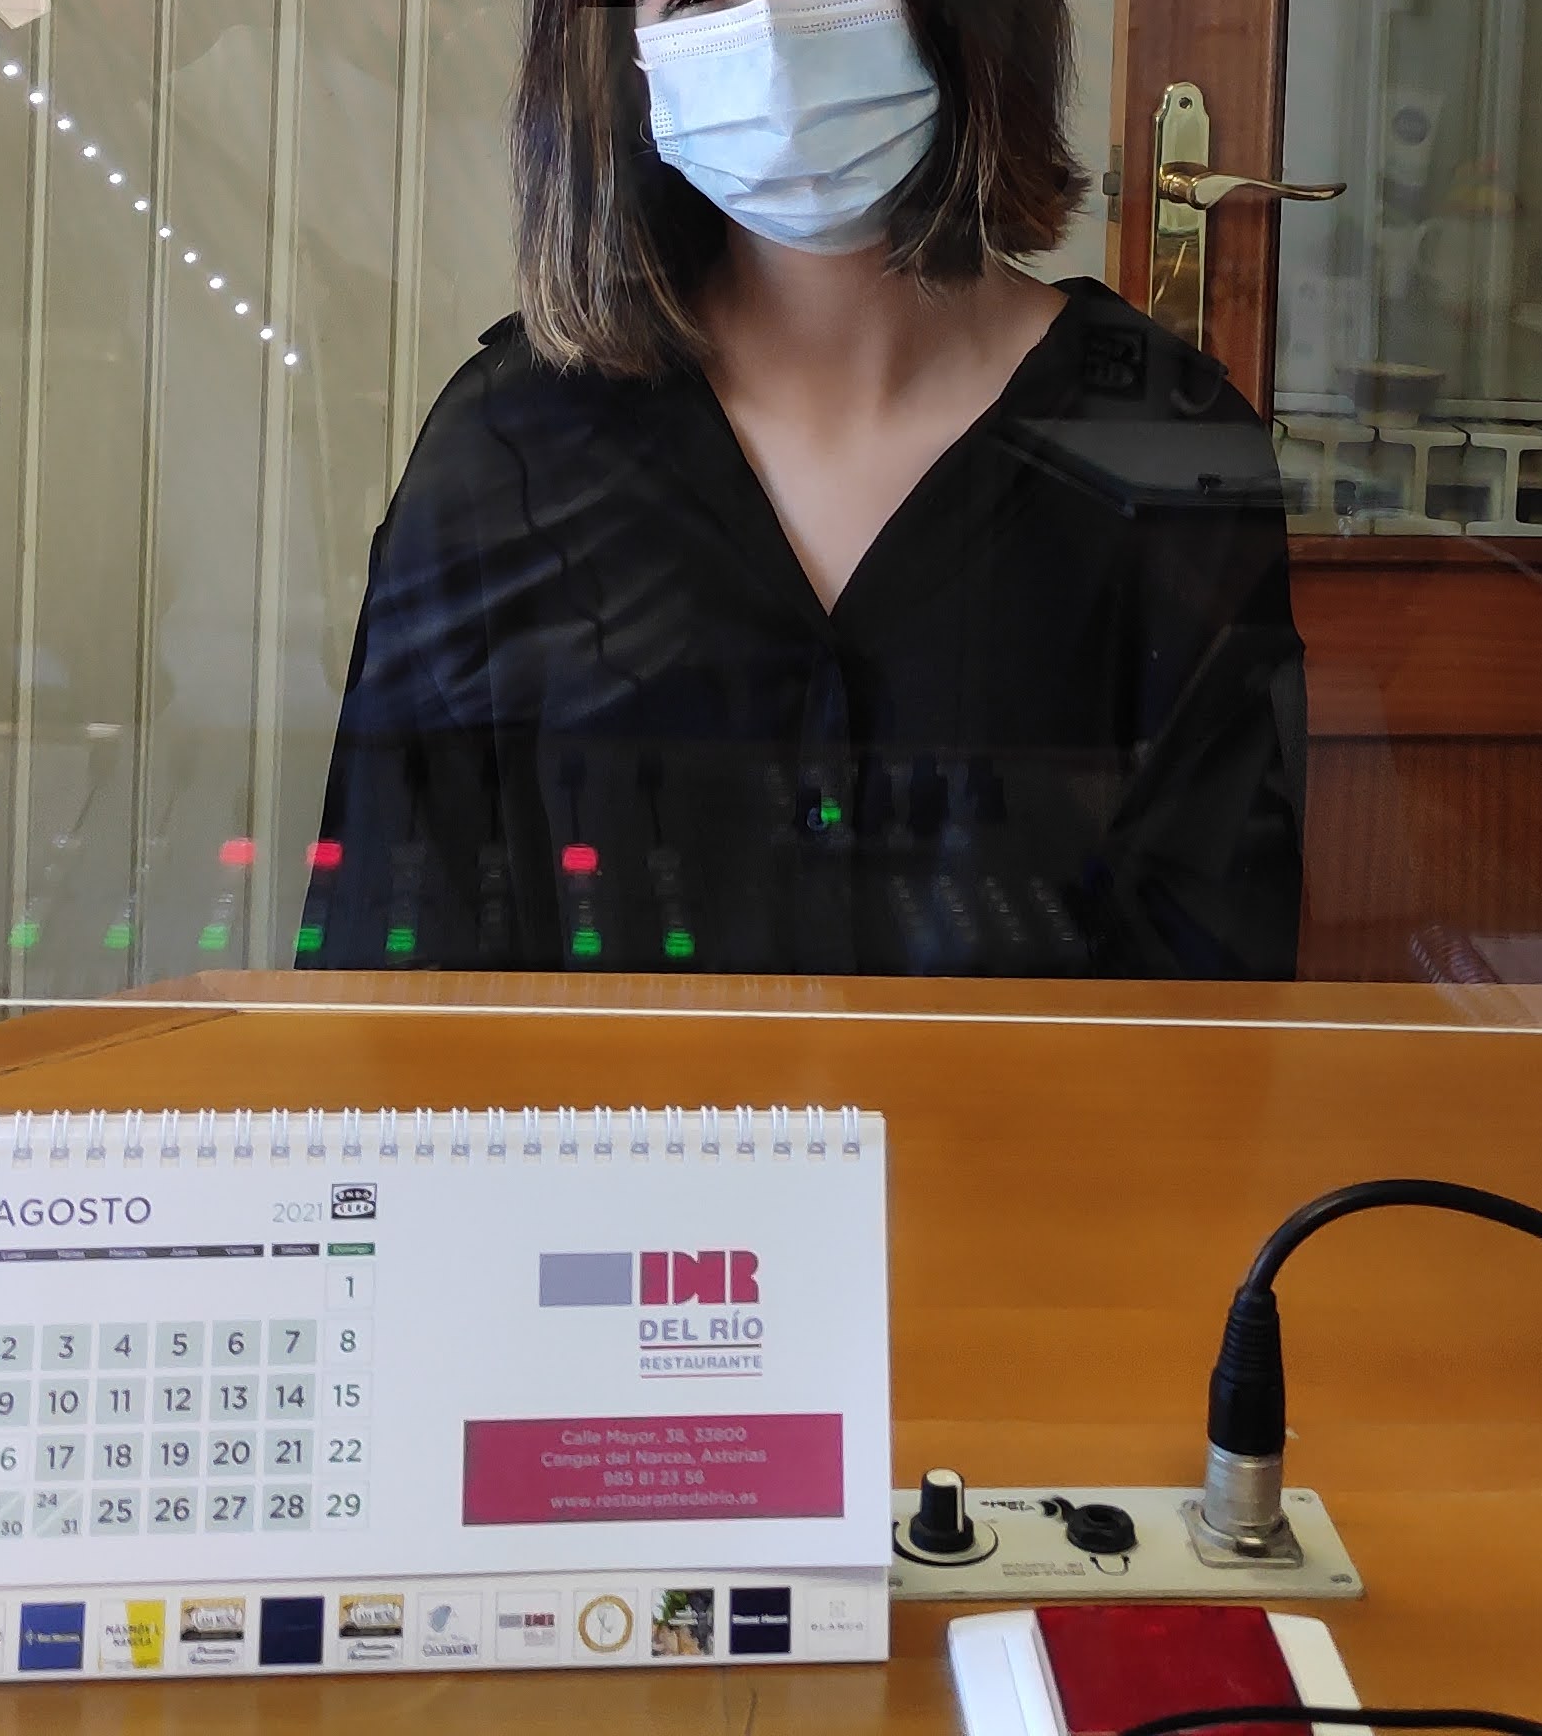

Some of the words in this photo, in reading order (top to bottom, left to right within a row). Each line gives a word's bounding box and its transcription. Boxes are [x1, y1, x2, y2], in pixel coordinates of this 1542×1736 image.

[272, 1202, 324, 1223] 2021
[345, 1276, 354, 1298] 1
[639, 1318, 698, 1341] DEL
[710, 1310, 764, 1340] RÍO
[1, 1336, 18, 1360] 2
[59, 1335, 74, 1359] 3
[114, 1334, 132, 1357] 4
[171, 1333, 188, 1357] 5
[228, 1332, 245, 1355] 6
[285, 1330, 301, 1354] 7
[339, 1329, 356, 1353] 8
[640, 1354, 763, 1370] RESTAURANTE
[48, 1390, 79, 1414] 10
[110, 1389, 131, 1413] 11
[164, 1388, 191, 1411] 12
[220, 1386, 248, 1410] 13
[275, 1385, 305, 1408] 14
[333, 1384, 360, 1407] 15
[562, 1429, 601, 1446] Calle
[47, 1445, 74, 1470] 17
[104, 1444, 132, 1467] 18
[160, 1442, 189, 1466] 19
[213, 1441, 250, 1464] 20
[275, 1440, 302, 1463] 21
[328, 1439, 362, 1462] 22
[541, 1451, 600, 1469] Cangas
[606, 1450, 630, 1466] del
[702, 1447, 767, 1464] Asturias
[98, 1498, 132, 1523] 25
[155, 1498, 189, 1522] 26
[213, 1495, 247, 1521] 27
[270, 1494, 304, 1519] 28
[326, 1493, 360, 1518] 29
